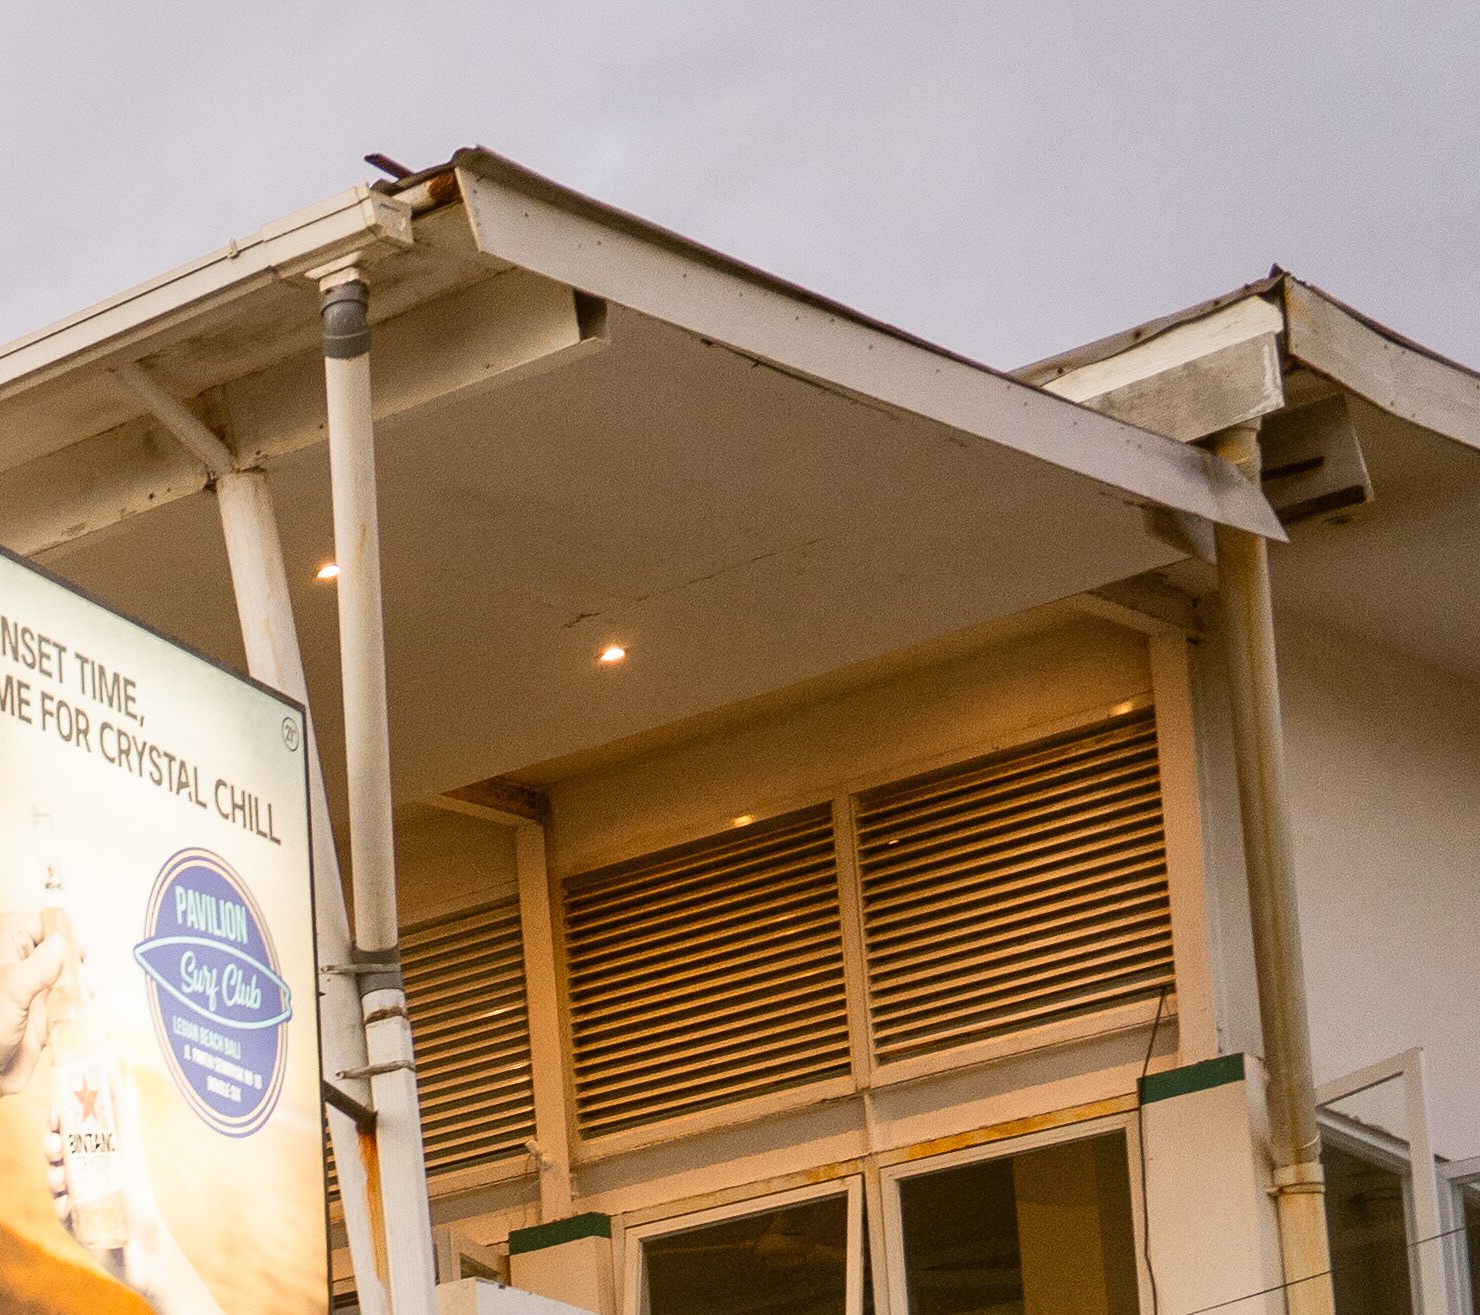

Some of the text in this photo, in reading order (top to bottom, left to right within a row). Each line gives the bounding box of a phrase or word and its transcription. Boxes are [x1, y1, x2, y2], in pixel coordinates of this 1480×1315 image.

[75, 651, 146, 727] TIME,
[40, 691, 92, 753] FOR
[99, 721, 208, 810] CRYSTAL
[214, 778, 282, 846] CHILL
[175, 885, 250, 945] PAVILION
[180, 950, 263, 1012] Surf Club
